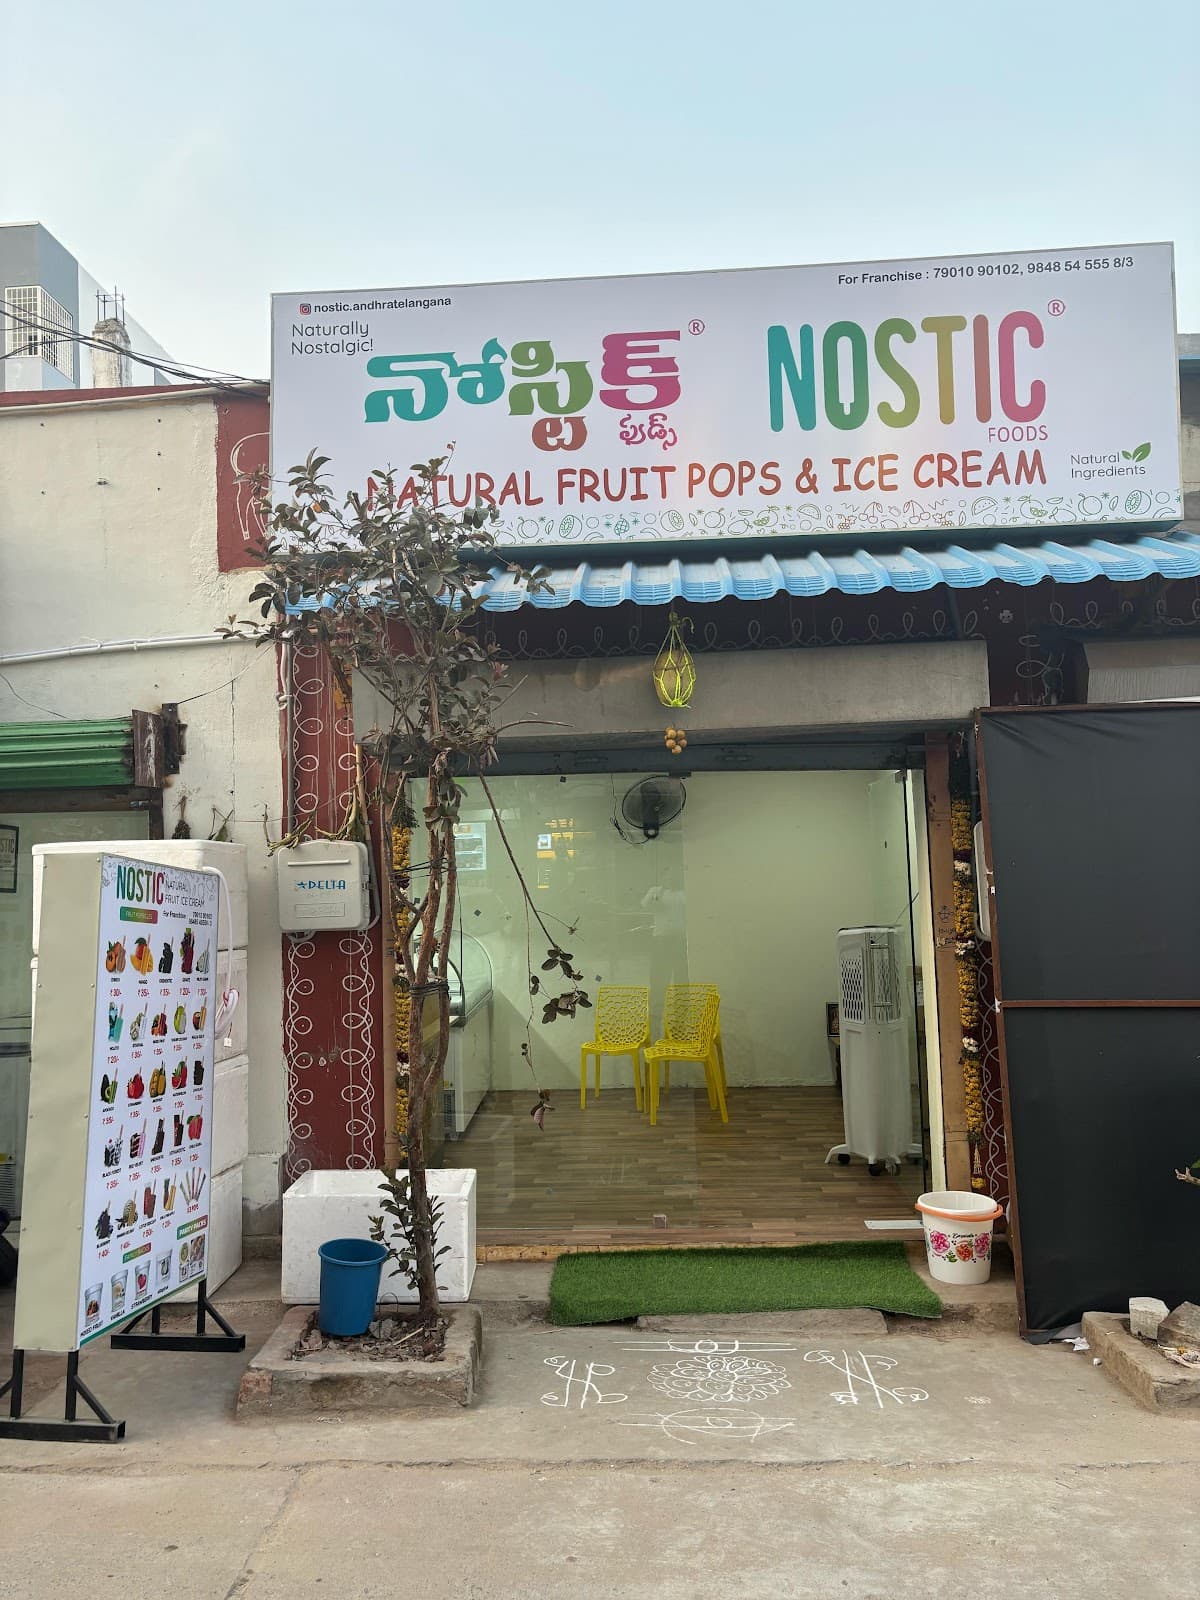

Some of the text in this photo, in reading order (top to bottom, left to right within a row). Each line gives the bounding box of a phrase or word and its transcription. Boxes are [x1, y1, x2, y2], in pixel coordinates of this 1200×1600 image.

[838, 274, 856, 285] For
[861, 270, 922, 284] Franchise
[933, 266, 974, 279] 79010
[977, 264, 1024, 277] 90102,
[1027, 261, 1061, 274] 9848
[1064, 260, 1081, 272] 54
[1084, 258, 1110, 271] 555
[1113, 256, 1134, 269] 8/3
[314, 297, 452, 313] nostic.andhratelangana
[292, 320, 369, 338] Naturally
[291, 338, 373, 356] Nostalgic!
[767, 310, 1046, 433] NOSTIC
[988, 425, 1048, 443] FOODS
[1070, 452, 1120, 466] Natural
[557, 465, 676, 505] FRUIT
[688, 460, 782, 498] POPS
[795, 457, 818, 494] &
[832, 453, 899, 492] ICE
[913, 449, 1047, 489] CREAM
[1071, 465, 1146, 481] Ingredients
[116, 864, 165, 905] NOSTIC
[308, 879, 346, 890] DELTA
[164, 894, 205, 908] FRUIT ICE CREAM
